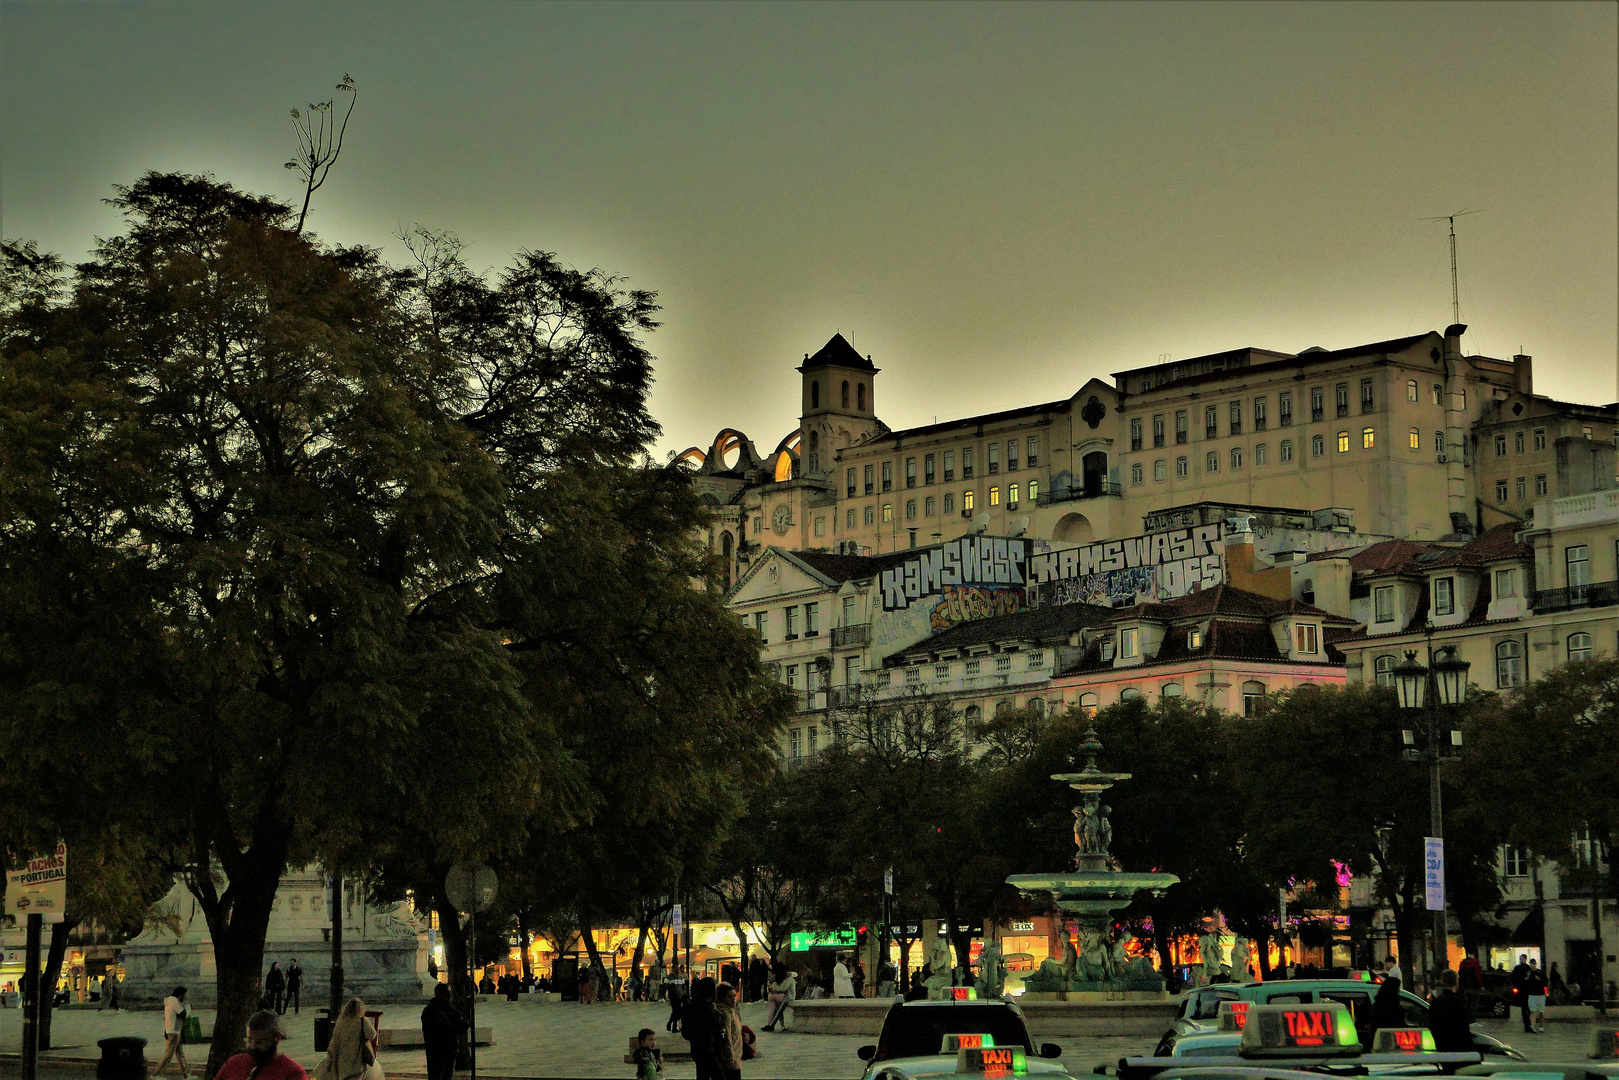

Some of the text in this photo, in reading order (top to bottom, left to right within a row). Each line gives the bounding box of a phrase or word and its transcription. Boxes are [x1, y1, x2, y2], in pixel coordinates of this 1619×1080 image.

[20, 868, 65, 883] PORTUGAL
[1283, 1011, 1333, 1037] TAXI
[958, 1035, 981, 1048] TAXI
[1394, 1031, 1421, 1046] TAXI
[980, 1049, 1012, 1064] TAXI
